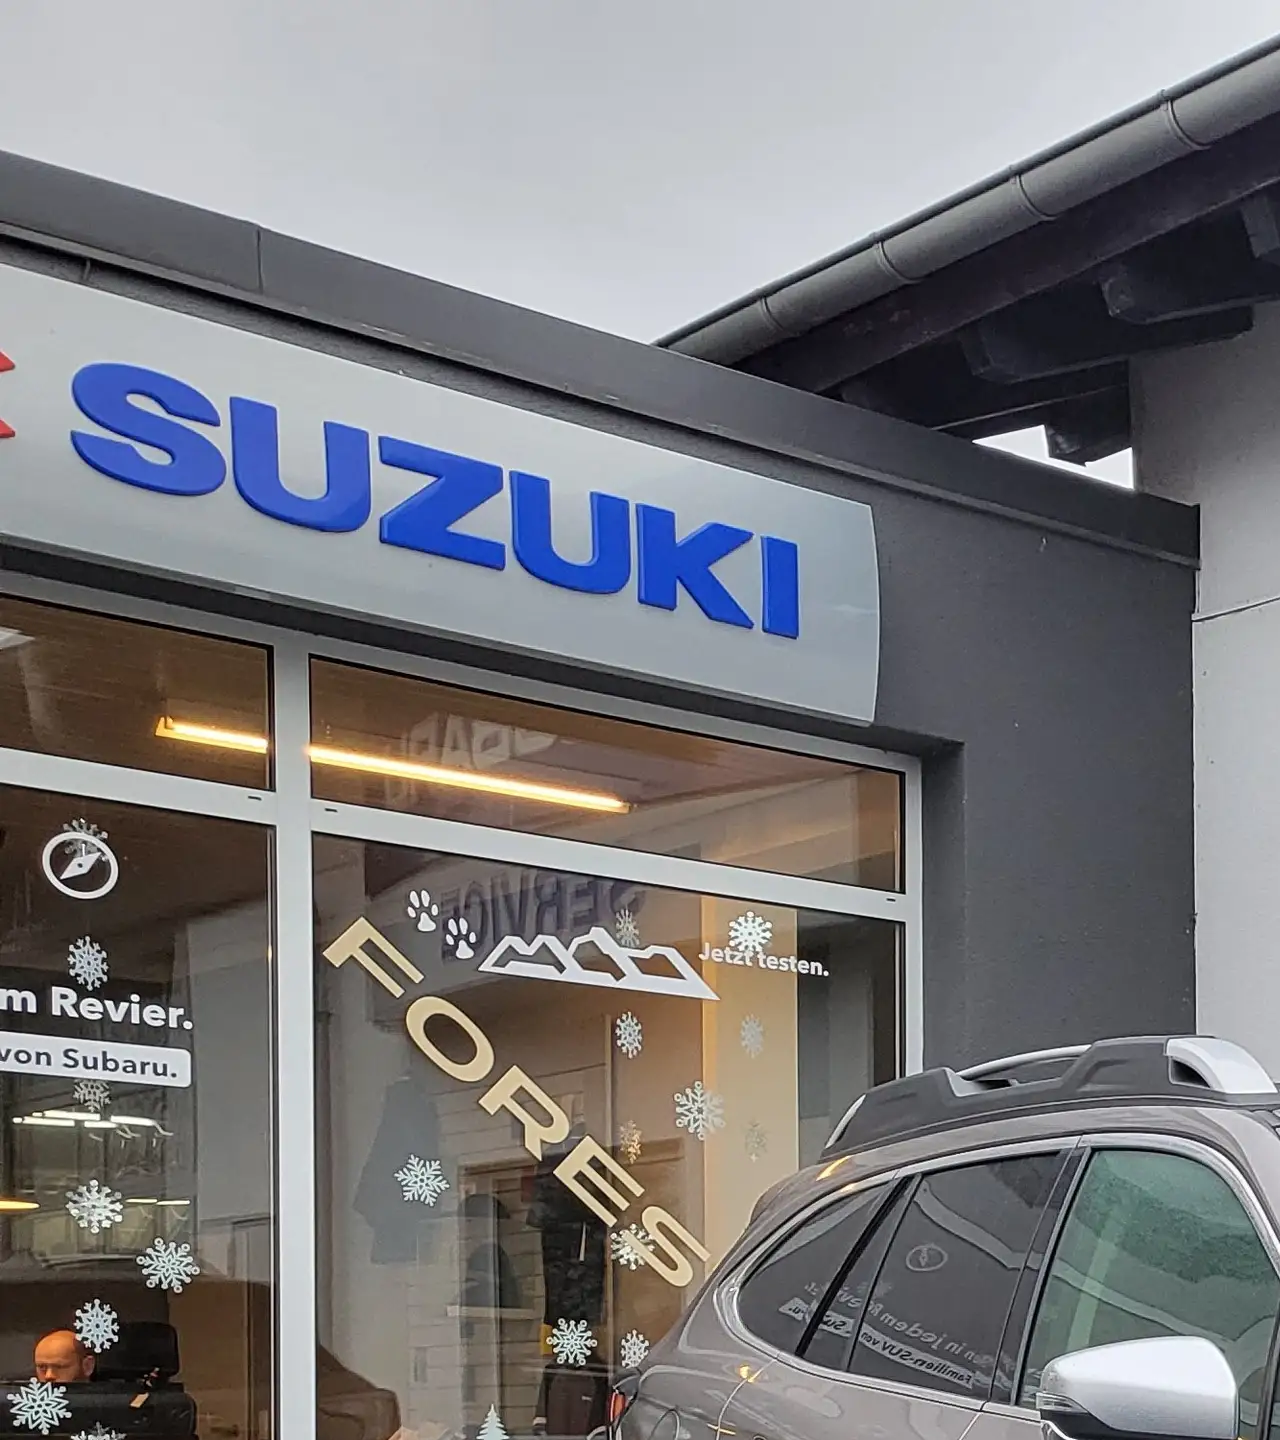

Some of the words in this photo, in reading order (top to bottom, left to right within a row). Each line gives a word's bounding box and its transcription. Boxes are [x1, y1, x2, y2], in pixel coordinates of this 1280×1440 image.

[70, 361, 800, 640] SUZUKI
[698, 942, 755, 967] Jetzt
[757, 952, 830, 977] testen.
[51, 985, 193, 1030] Revier.
[63, 1048, 177, 1078] Subaru.
